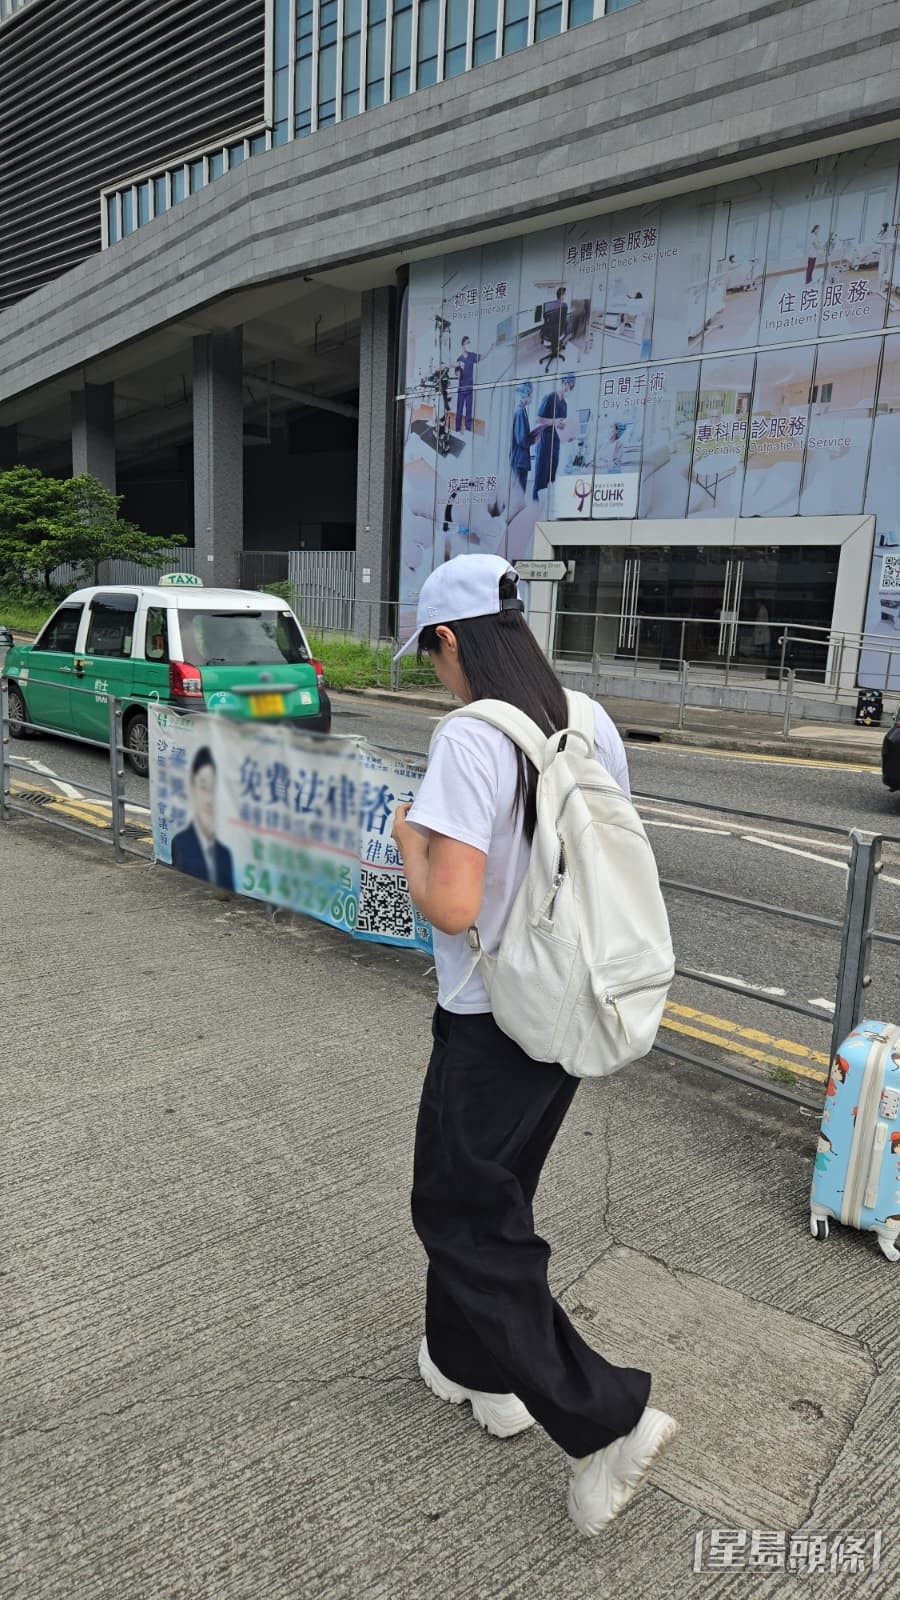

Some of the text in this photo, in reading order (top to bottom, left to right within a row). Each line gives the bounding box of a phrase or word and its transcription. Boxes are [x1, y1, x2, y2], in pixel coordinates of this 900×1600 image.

[566, 227, 657, 265] 身體檢查服務
[611, 256, 637, 269] Check
[642, 247, 679, 261] Service
[778, 279, 869, 314] 住院服務
[765, 305, 870, 330] Inpatient Service
[604, 371, 665, 395] 日間手術
[603, 399, 620, 410] Day
[697, 415, 807, 443] 專科門診服務
[809, 436, 852, 449] Service
[593, 489, 624, 501] CUHK
[167, 575, 198, 585] TAXI
